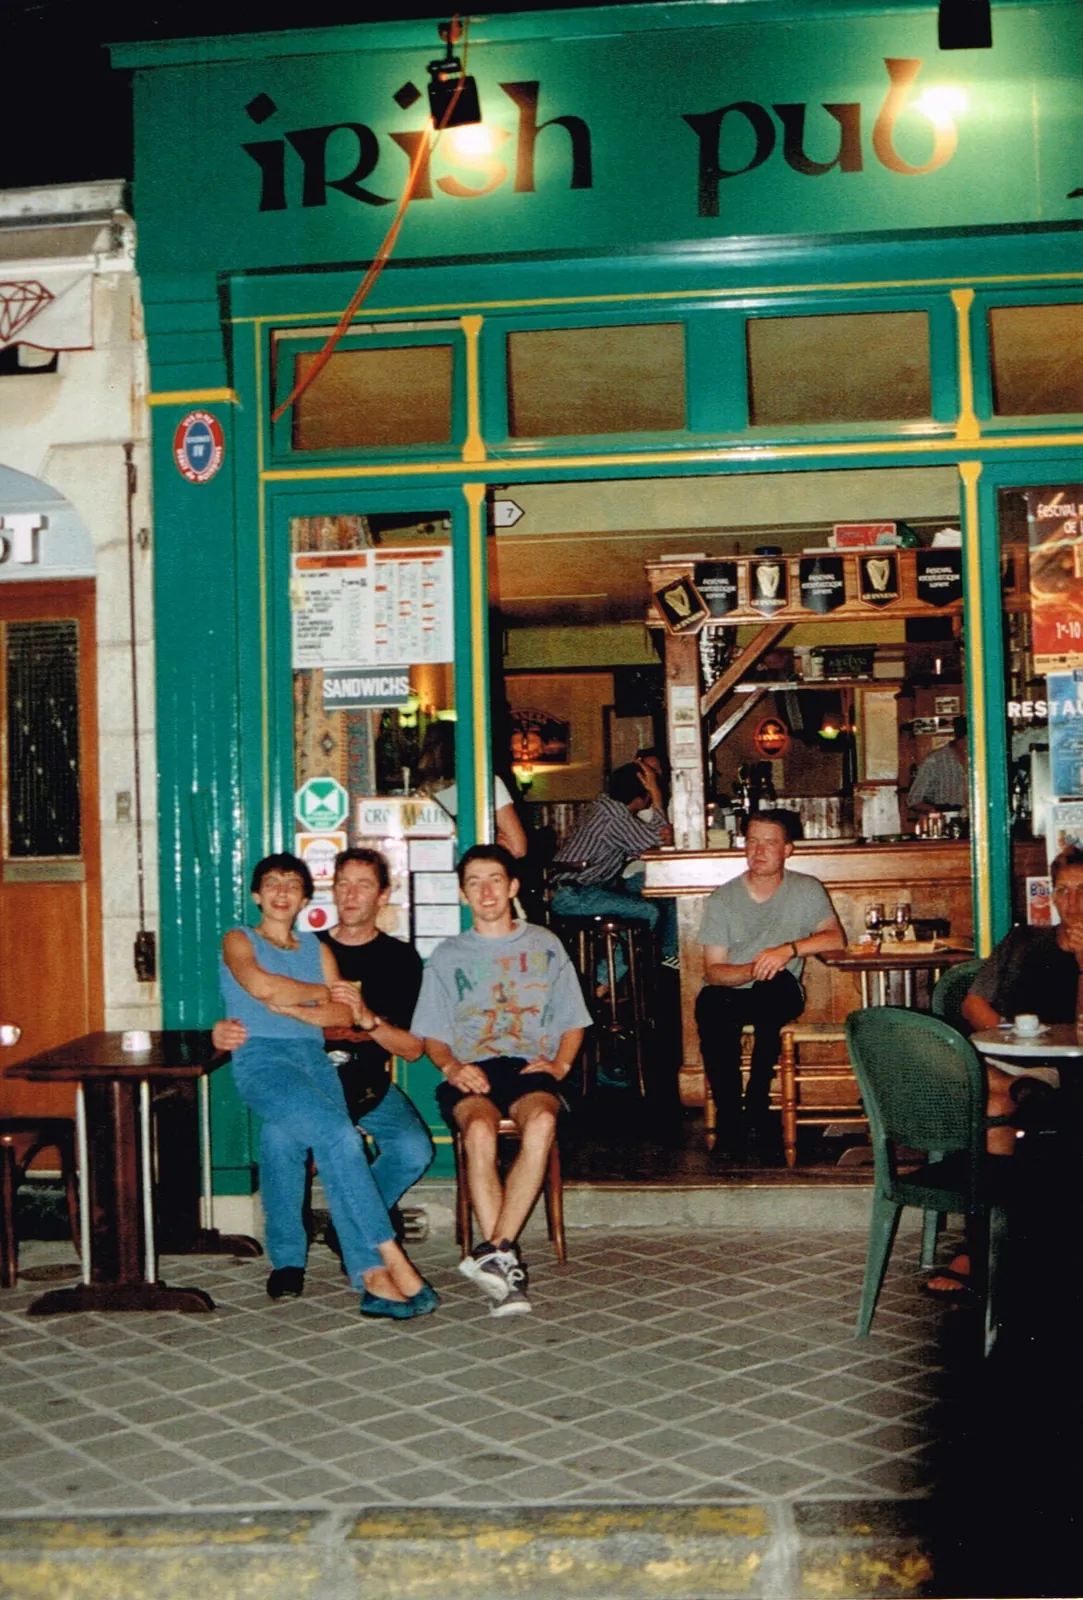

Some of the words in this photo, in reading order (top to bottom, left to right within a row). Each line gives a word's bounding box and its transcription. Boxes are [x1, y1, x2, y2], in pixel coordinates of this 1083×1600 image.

[681, 56, 959, 217] pub
[506, 508, 514, 518] 7
[323, 677, 410, 698] SANDWICHS
